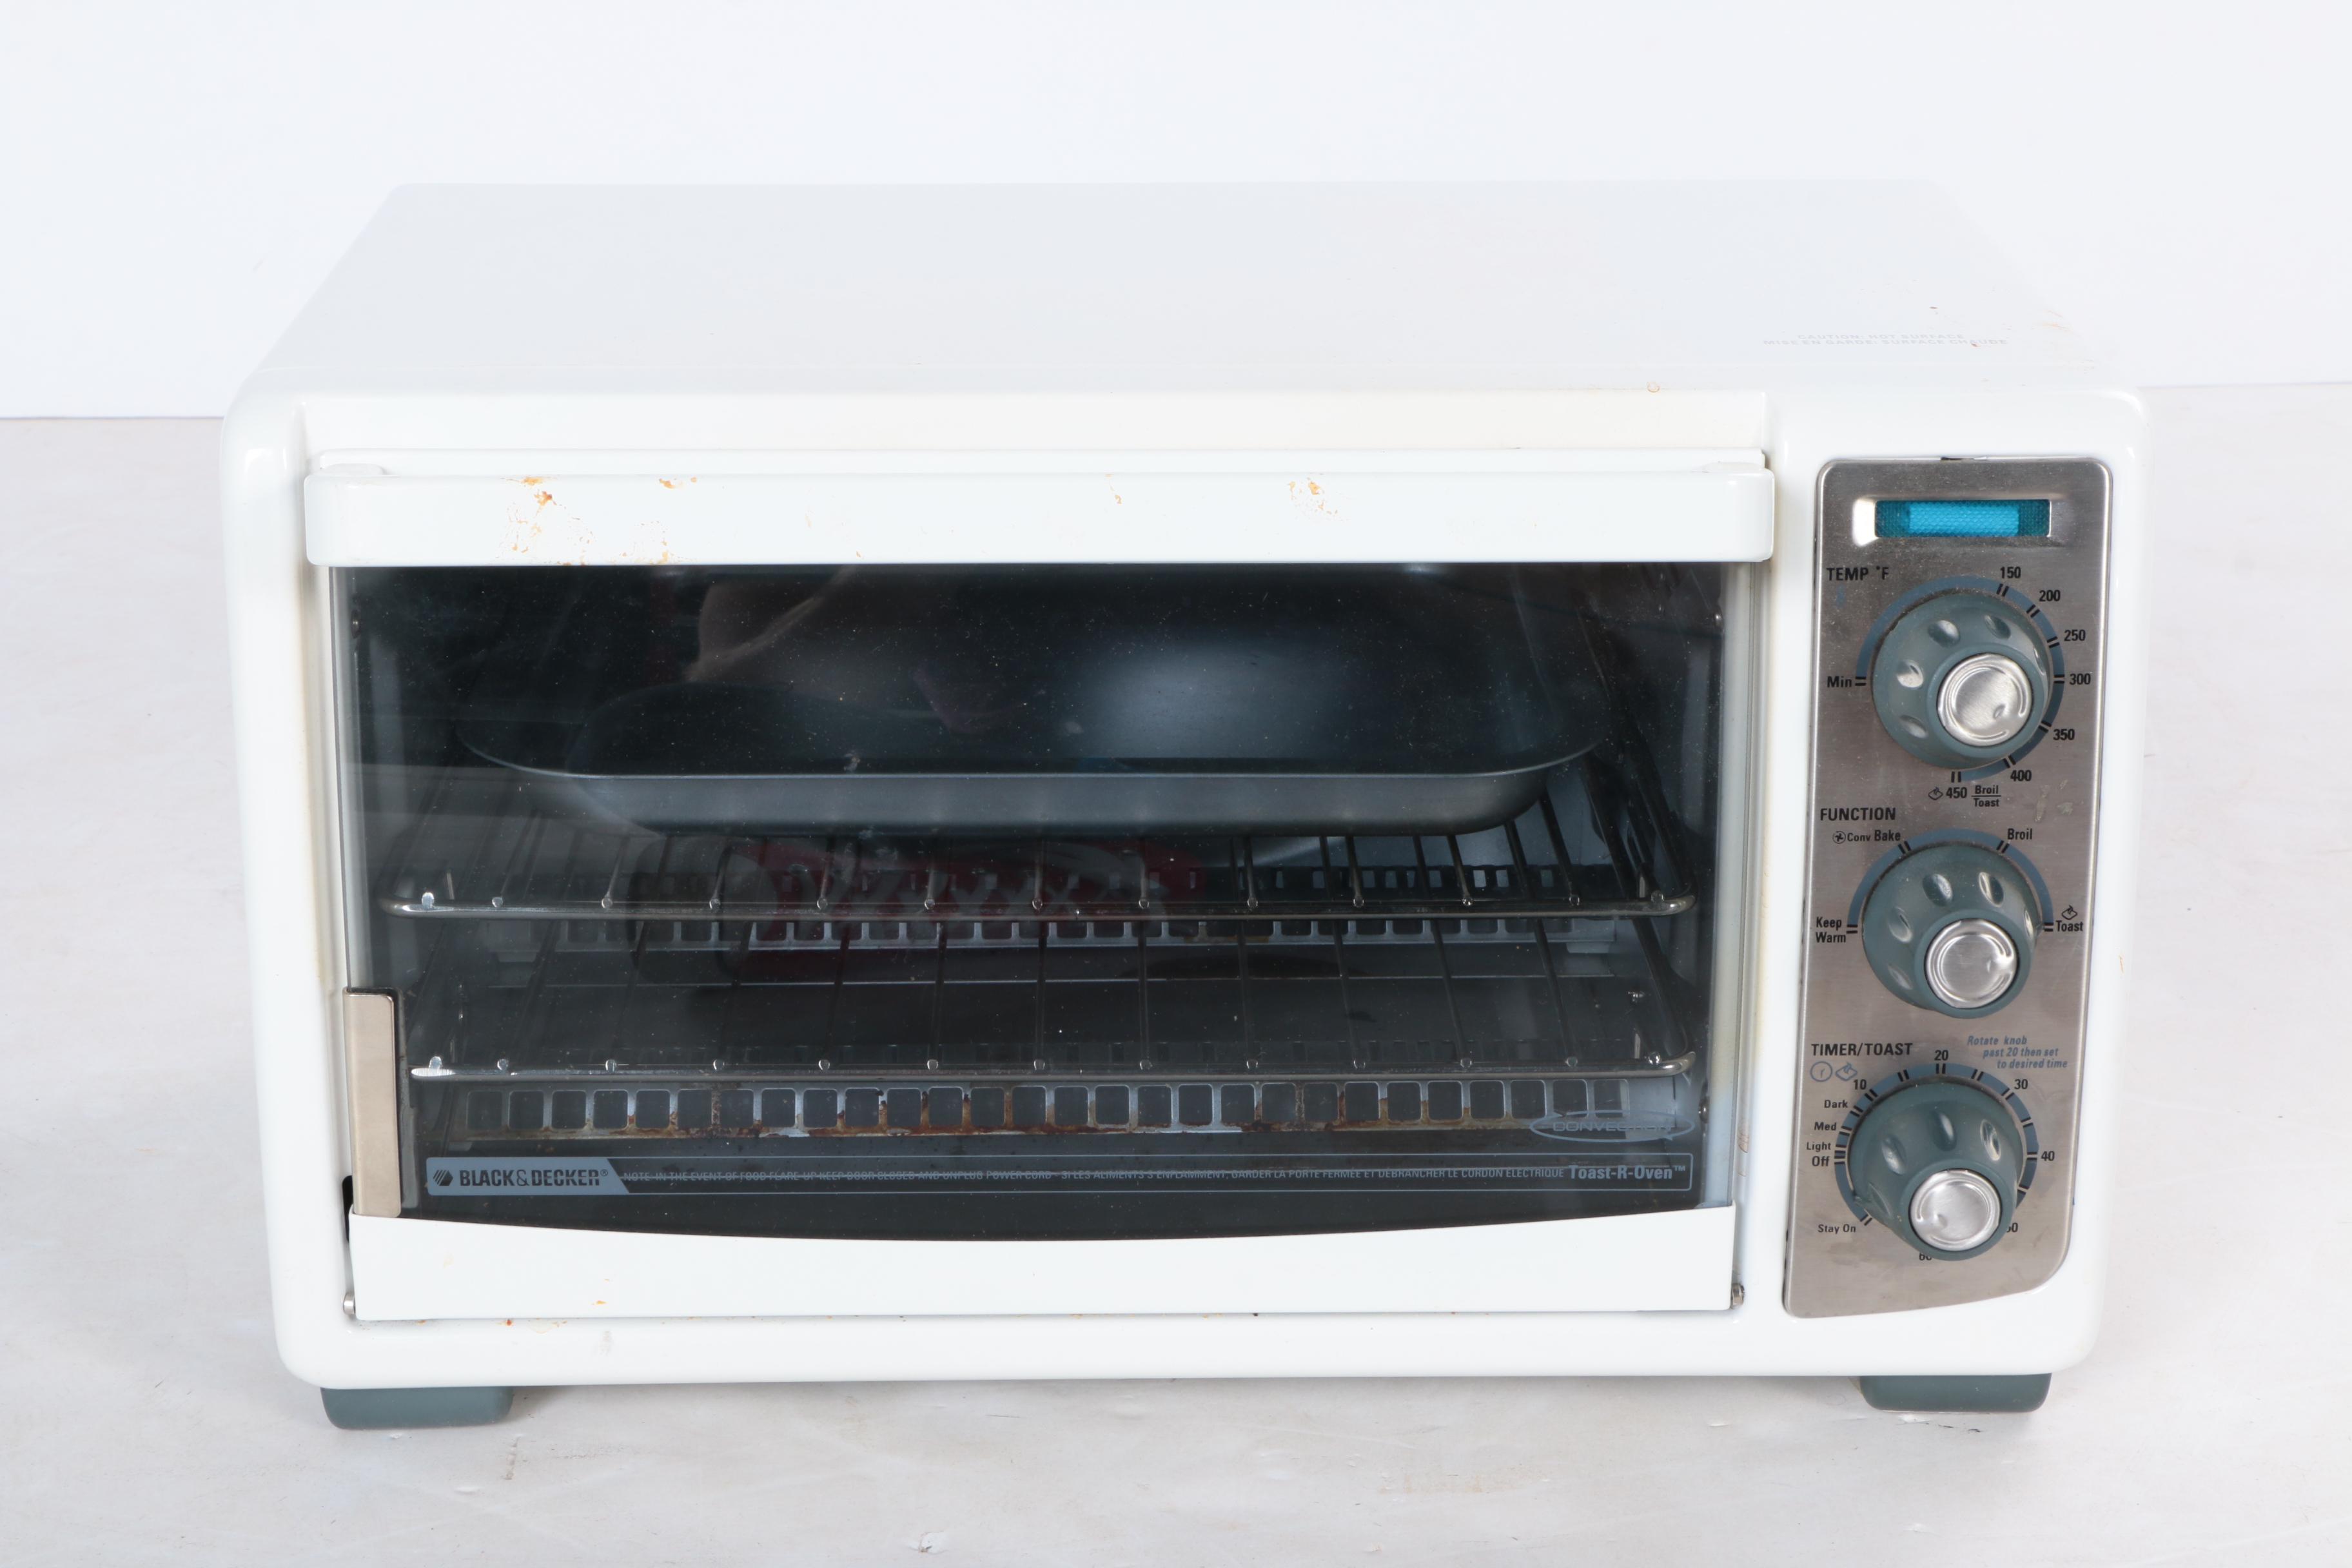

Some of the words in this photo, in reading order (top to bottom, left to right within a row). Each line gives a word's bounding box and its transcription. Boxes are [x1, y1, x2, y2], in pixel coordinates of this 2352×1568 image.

[1826, 567, 1868, 580] TEMP
[2000, 567, 2022, 579] 150
[2039, 589, 2061, 602] 200
[2064, 629, 2086, 642] 250
[1827, 676, 1852, 688] Min
[2069, 674, 2091, 685] 300
[2053, 729, 2075, 740] 350
[2010, 769, 2032, 781] 400
[1946, 787, 1967, 798] 450
[1975, 785, 1999, 794] Broil
[1974, 798, 2000, 807] Toast
[1819, 807, 1896, 821] FUNCTION
[1847, 832, 1871, 842] Conv
[1874, 829, 1901, 841] Bake
[2007, 828, 2033, 840] Broil
[1816, 916, 1842, 929] Keep
[2055, 921, 2084, 932] Toast
[1816, 932, 1847, 943] Warm
[1966, 1035, 1999, 1045] Rotate
[2003, 1035, 2028, 1045] knob
[1811, 1043, 1913, 1056] TIMER/TOAST
[1983, 1049, 2004, 1059] past
[2006, 1047, 2018, 1057] 20
[2020, 1047, 2042, 1056] then
[2043, 1048, 2059, 1057] set
[1934, 1050, 1949, 1061] 20
[1997, 1059, 2007, 1068] to
[2009, 1059, 2045, 1068] desired
[2046, 1058, 2068, 1068] time
[1854, 1079, 1867, 1090] 10
[2014, 1079, 2028, 1090] 30
[1824, 1099, 1848, 1109] Dark
[1814, 1121, 1837, 1131] Med
[1806, 1141, 1832, 1151] Light
[1812, 1155, 1830, 1166] Off
[2041, 1150, 2055, 1162] 40
[656, 1172, 667, 1181] IN
[670, 1172, 688, 1181] THE
[691, 1172, 722, 1181] EVENT
[725, 1172, 736, 1181] OF
[740, 1171, 766, 1181] FOOD
[819, 1171, 841, 1180] KEEP
[847, 1171, 874, 1180] DOOR
[877, 1171, 915, 1180] CLOSED
[918, 1171, 939, 1180] AND
[943, 1171, 983, 1180] UNPLUG
[986, 1171, 1023, 1179] POWER
[1025, 1171, 1052, 1179] CORD
[1062, 1171, 1072, 1179] SI
[1073, 1171, 1091, 1179] LES
[1093, 1170, 1144, 1179] ALIMENTS
[1231, 1170, 1271, 1179] GARDER
[1274, 1170, 1286, 1179] LA
[1289, 1170, 1320, 1179] PORTE
[1364, 1170, 1375, 1178] ET
[1448, 1169, 1458, 1177] LE
[1462, 1169, 1503, 1178] CORDON
[1818, 1224, 1839, 1235] Stay
[1842, 1224, 1856, 1233] On
